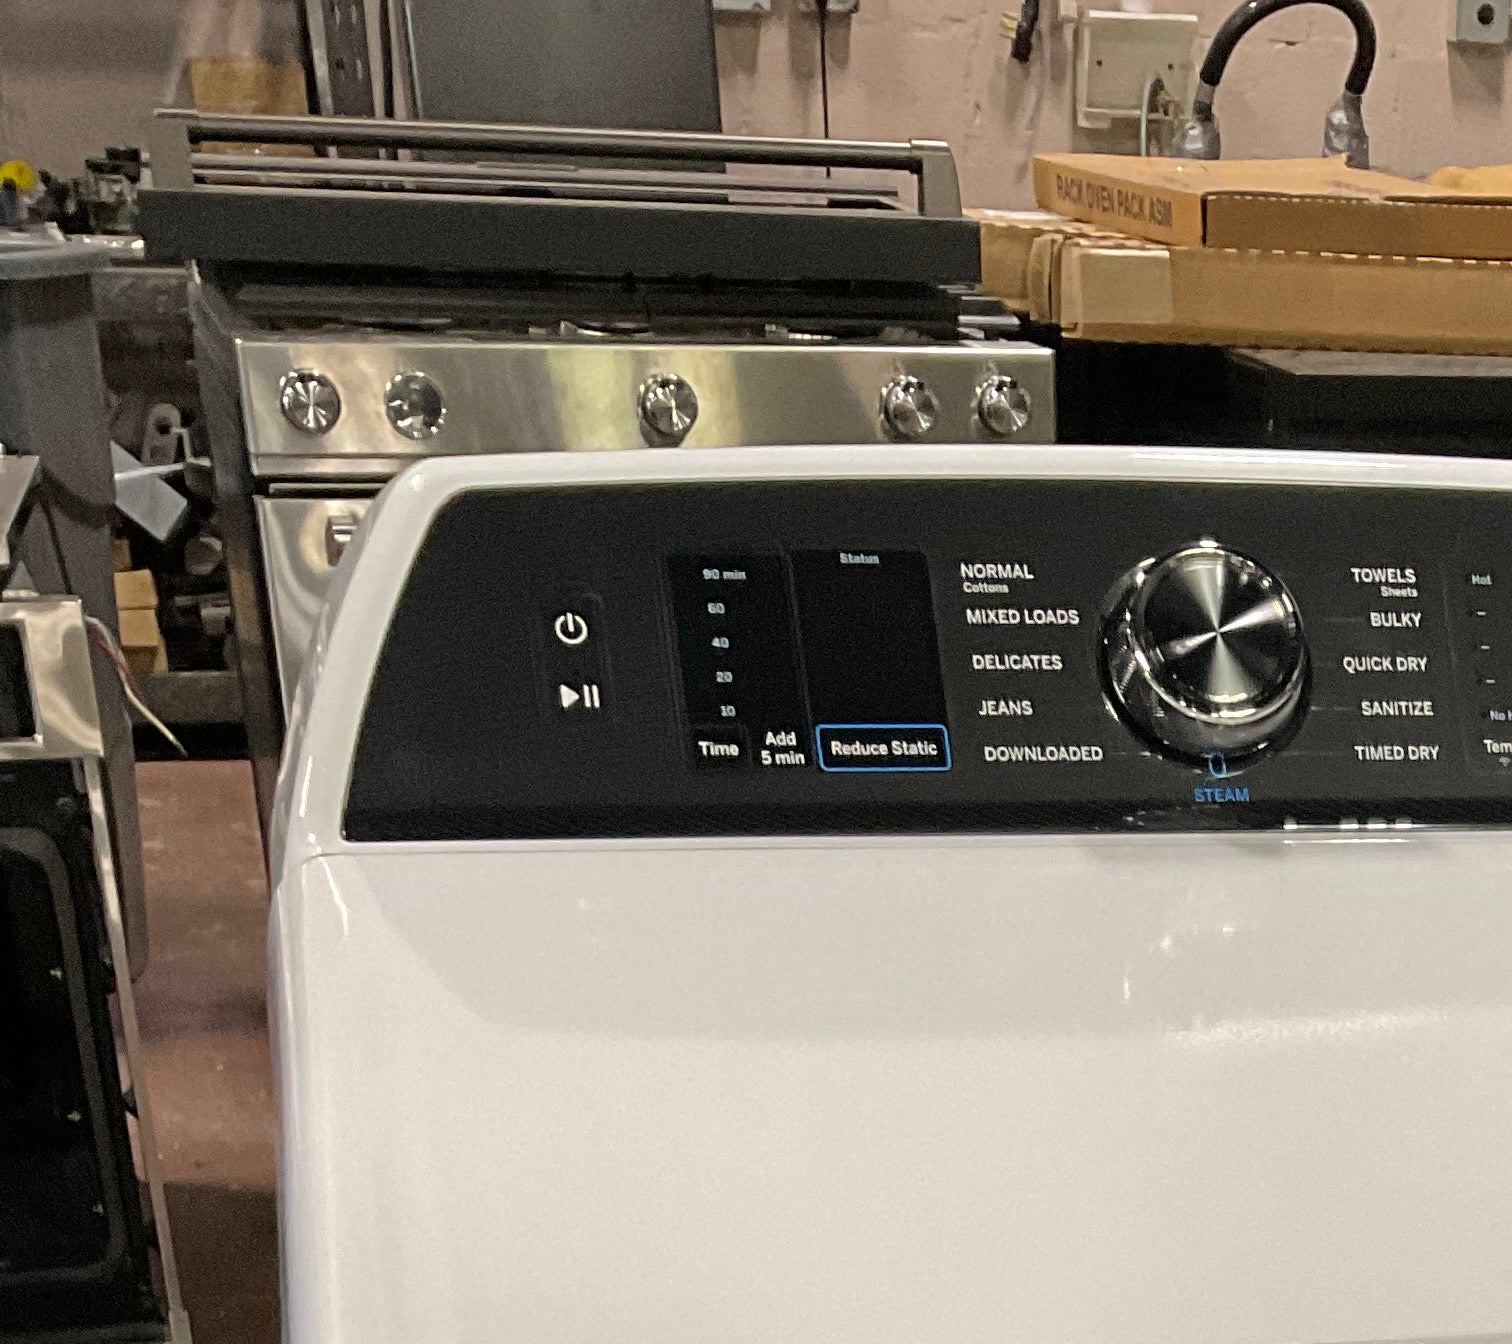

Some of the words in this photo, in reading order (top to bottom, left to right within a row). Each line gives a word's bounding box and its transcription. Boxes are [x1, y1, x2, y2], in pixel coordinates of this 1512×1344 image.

[1086, 180, 1115, 214] OVEN
[839, 552, 880, 565] Status
[702, 568, 720, 580] 90
[722, 569, 747, 581] min
[960, 562, 1035, 580] NORMAL
[1350, 567, 1417, 584] TOWELS
[962, 581, 1010, 594] Cottons
[1380, 585, 1419, 598] Sheets
[965, 608, 1021, 625] MIXED
[1023, 608, 1080, 625] LOADS
[1369, 611, 1422, 628] BULKY
[711, 636, 730, 649] 40
[971, 654, 1063, 671] DELICATES
[1342, 656, 1394, 674] QUICK
[1395, 656, 1428, 672] DRY
[715, 671, 733, 683] 20
[720, 705, 737, 717] 10
[978, 699, 1034, 716] JEANS
[1361, 700, 1434, 716] SANITIZE
[1489, 709, 1506, 721] No
[765, 731, 797, 747] Add
[697, 740, 740, 757] Time
[830, 740, 889, 756] Reduce
[890, 740, 938, 756] Static
[983, 745, 1104, 762] DOWNLOADED
[1353, 745, 1405, 761] TIMED
[1407, 745, 1440, 761] DRY
[760, 749, 773, 766] 5
[774, 750, 806, 765] min
[1193, 786, 1250, 803] STEAM
